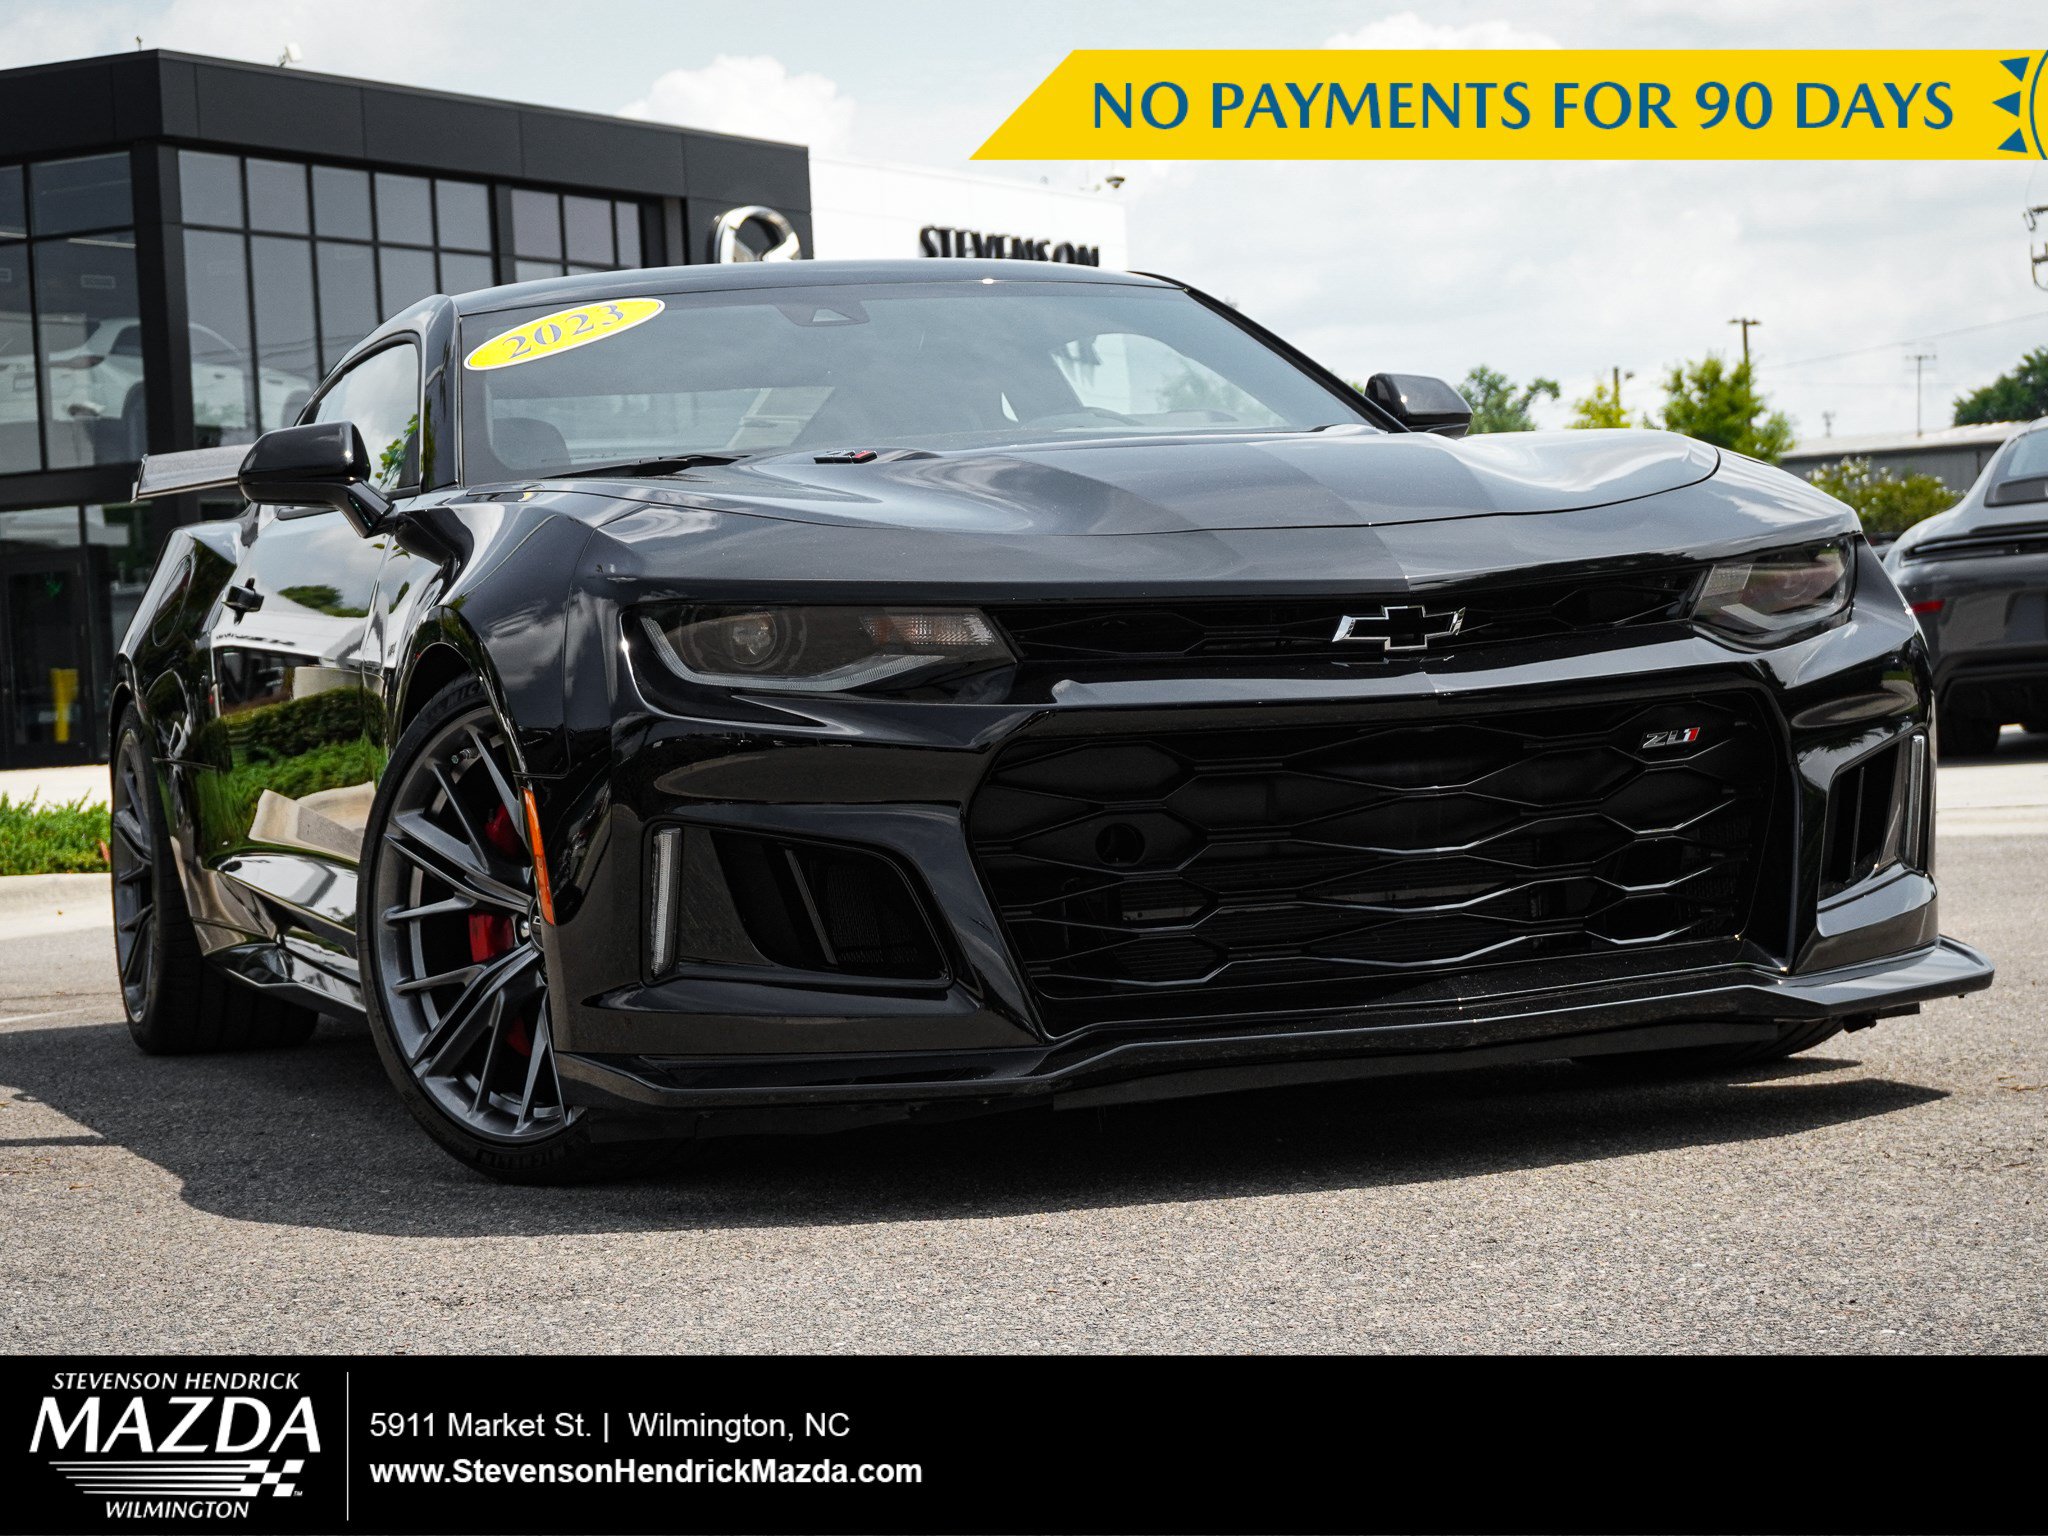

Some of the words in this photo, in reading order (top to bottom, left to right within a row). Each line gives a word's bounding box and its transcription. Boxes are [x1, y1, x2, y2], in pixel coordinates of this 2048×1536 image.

[919, 226, 1099, 267] STEVENSON
[502, 304, 622, 359] 2023
[1642, 727, 1700, 749] ZL1
